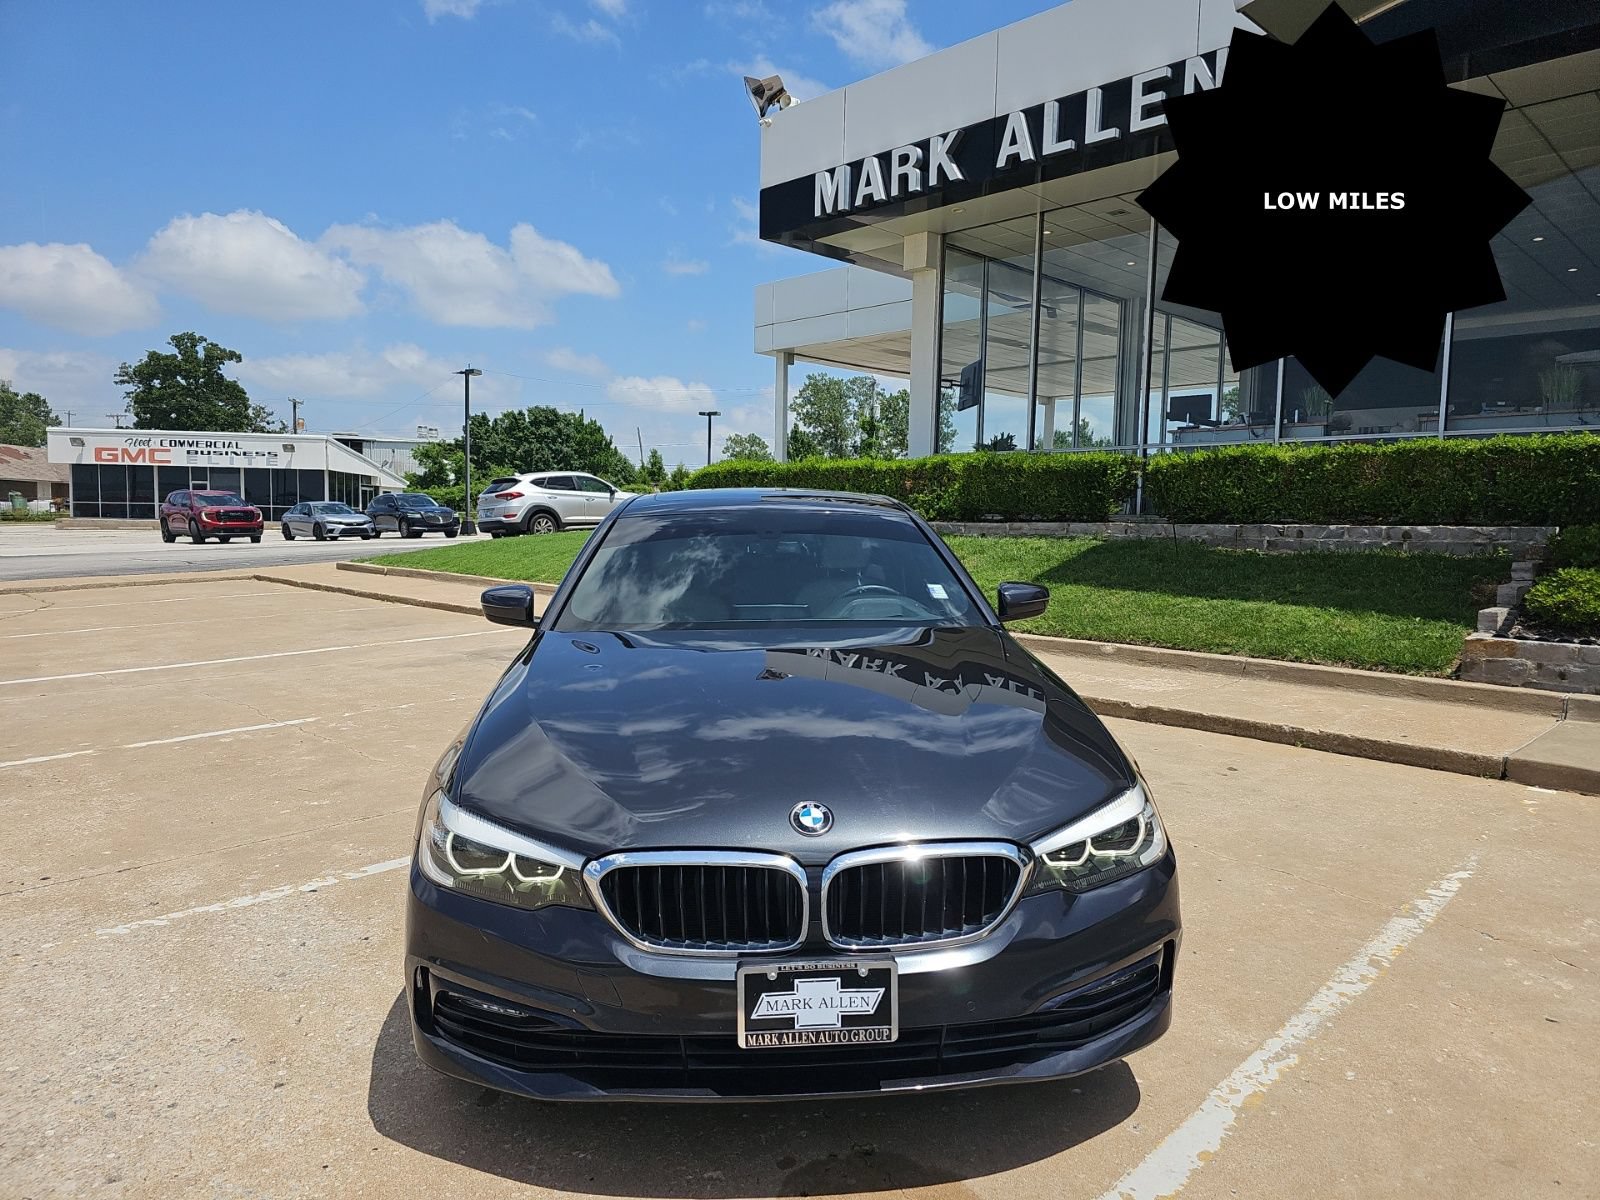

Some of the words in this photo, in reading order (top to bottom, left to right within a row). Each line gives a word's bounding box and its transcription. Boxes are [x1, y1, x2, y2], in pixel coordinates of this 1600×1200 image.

[814, 129, 966, 218] MARK
[995, 47, 1229, 169] ALLEN
[160, 439, 243, 449] COMMERCIAL
[94, 447, 172, 464] GMC
[186, 449, 279, 457] BUSINESS
[186, 455, 279, 467] ELITE
[766, 998, 813, 1012] MARK
[818, 996, 870, 1009] ALLEN
[747, 1033, 780, 1047] MARK
[782, 1032, 817, 1045] ALLEN
[819, 1030, 848, 1043] AUTO
[850, 1028, 890, 1042] GROUP
